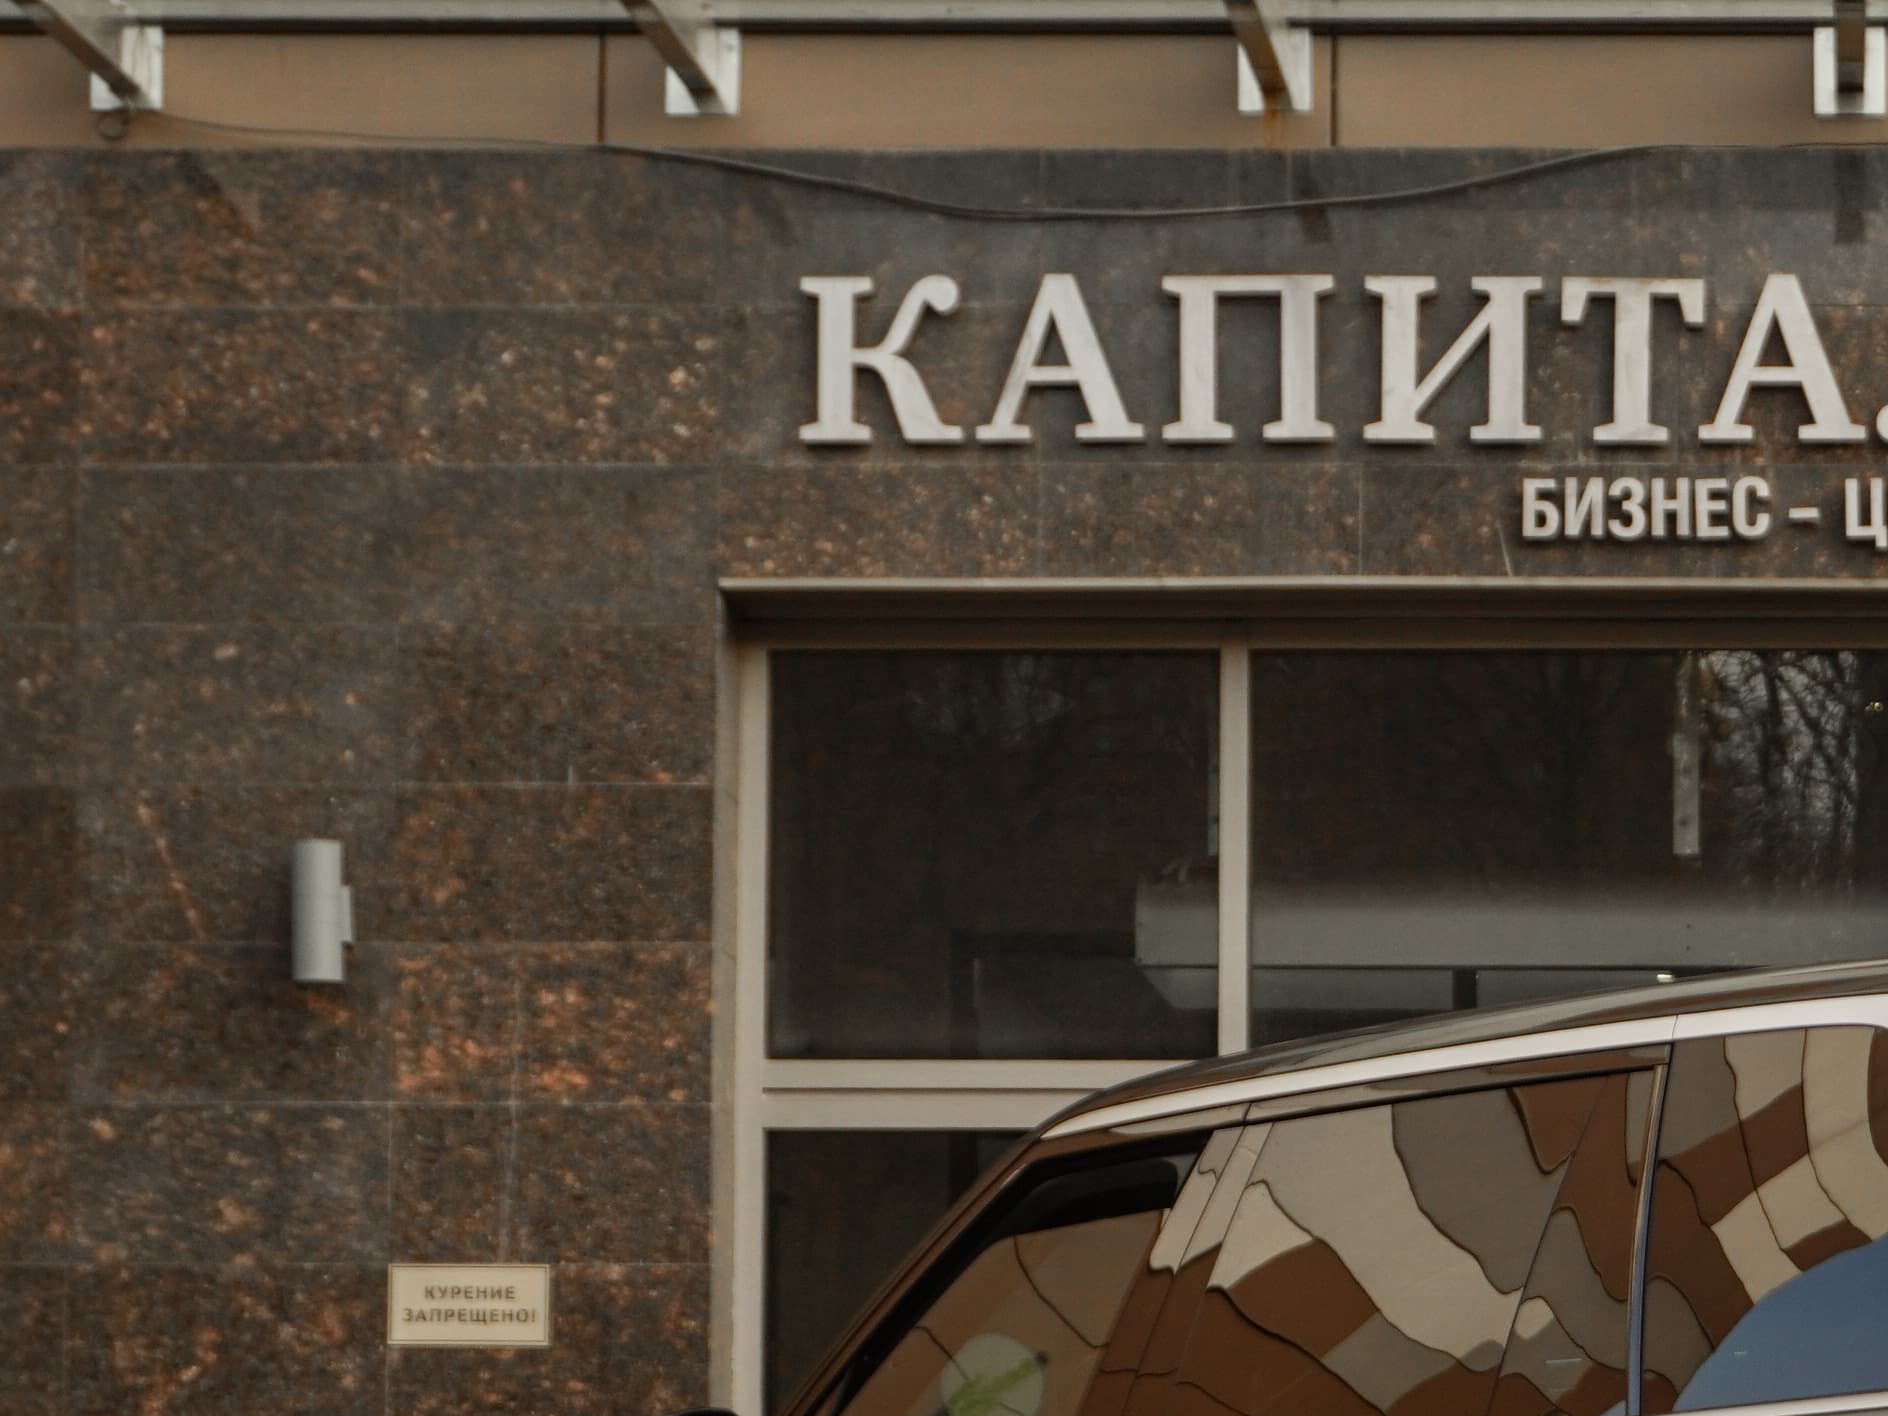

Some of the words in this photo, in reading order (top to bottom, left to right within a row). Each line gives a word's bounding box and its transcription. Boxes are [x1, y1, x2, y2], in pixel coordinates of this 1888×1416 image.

[1521, 475, 1772, 541] БИЗНЕС
[423, 1285, 517, 1301] КУРЕНИЕ
[402, 1307, 537, 1325] ЗАПРЕЩЕНО!
